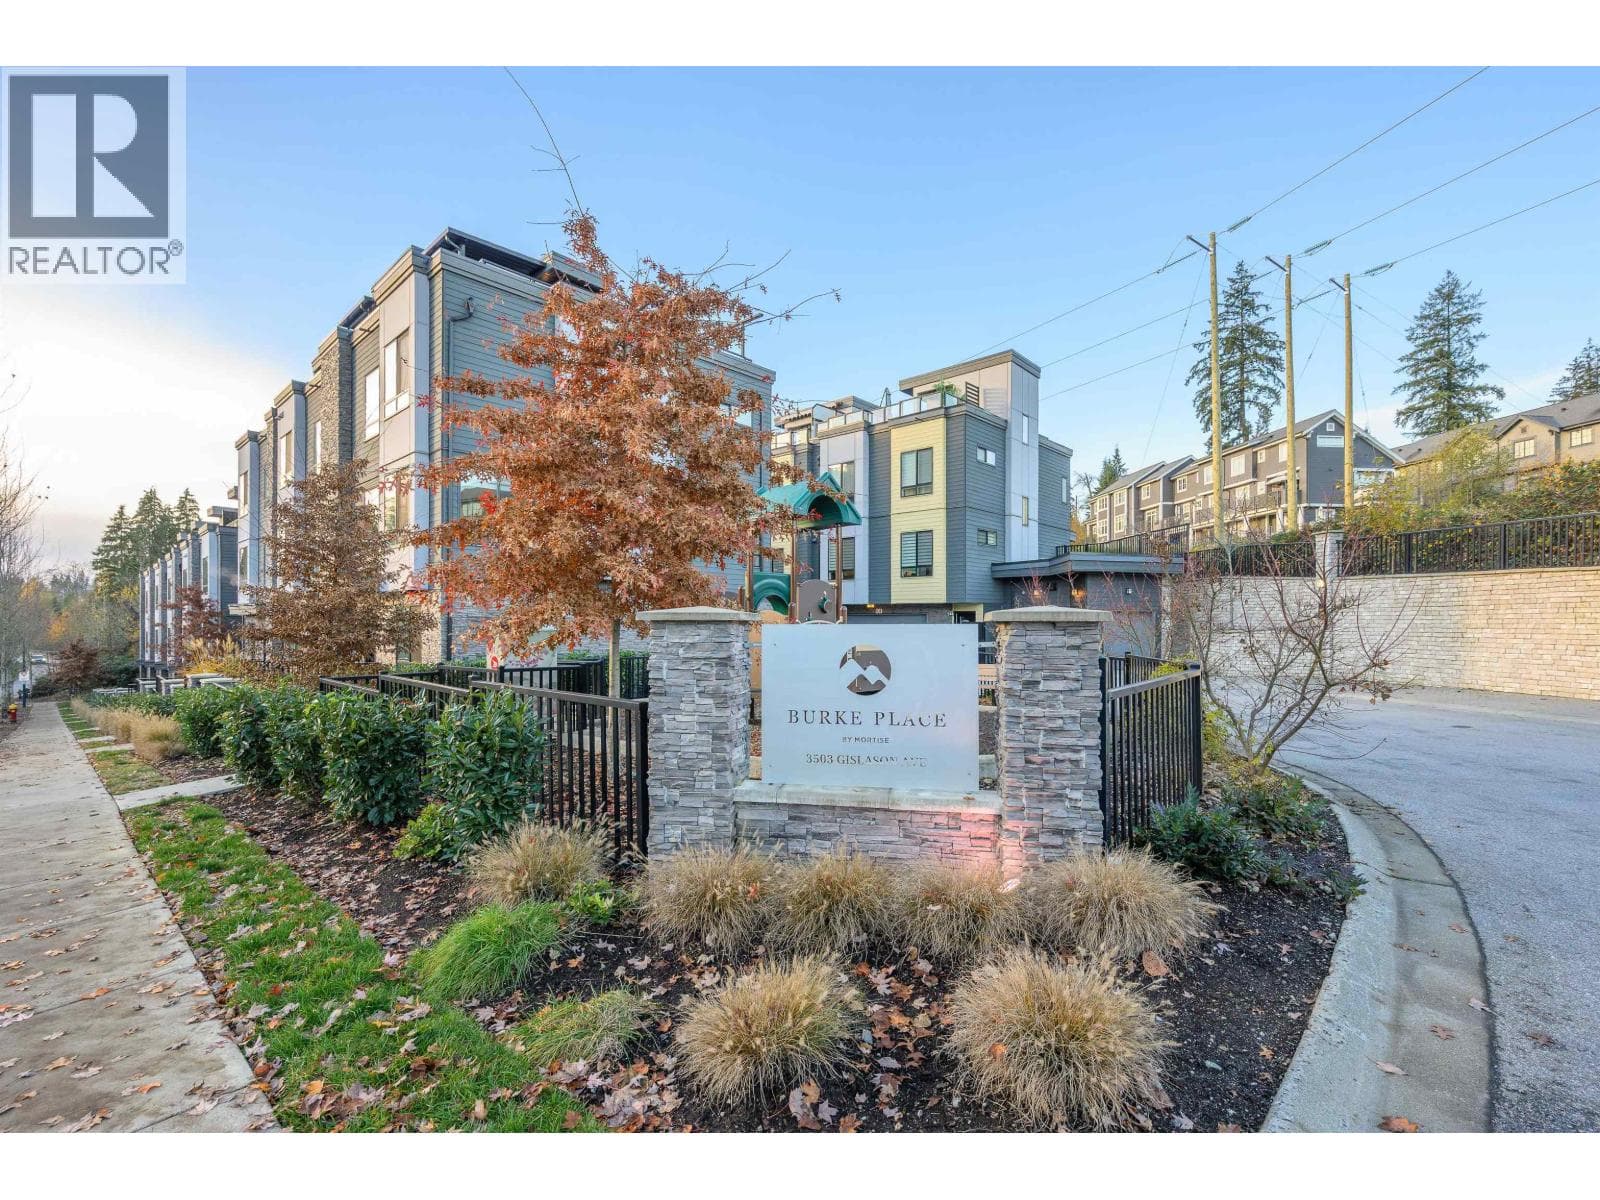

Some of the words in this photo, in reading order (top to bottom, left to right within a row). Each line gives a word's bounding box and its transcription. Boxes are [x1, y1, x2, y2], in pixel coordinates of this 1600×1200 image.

[787, 709, 862, 726] BURKE
[874, 711, 947, 728] PLACE
[854, 736, 890, 744] MORTISE
[806, 754, 834, 764] 3503
